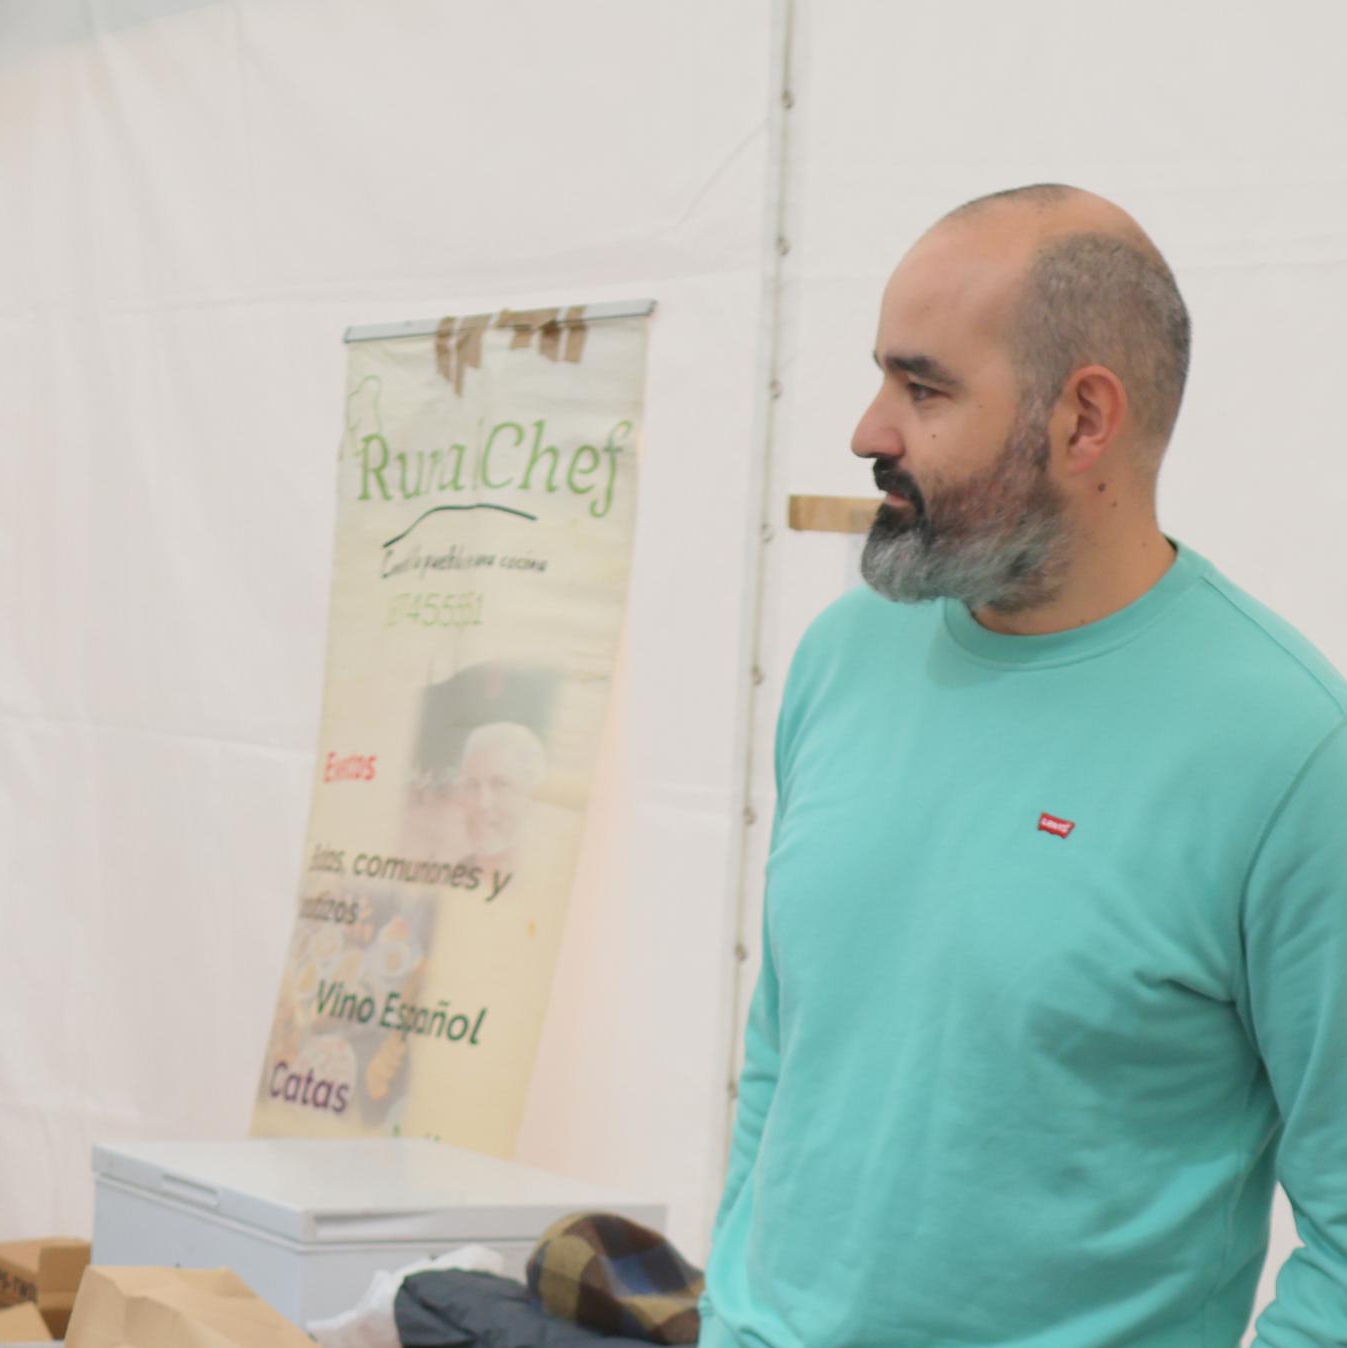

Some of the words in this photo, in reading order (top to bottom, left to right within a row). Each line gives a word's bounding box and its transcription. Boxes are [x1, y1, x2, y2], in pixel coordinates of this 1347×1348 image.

[485, 870, 514, 902] y
[316, 978, 375, 1024] Vino
[268, 1059, 350, 1113] Catas
